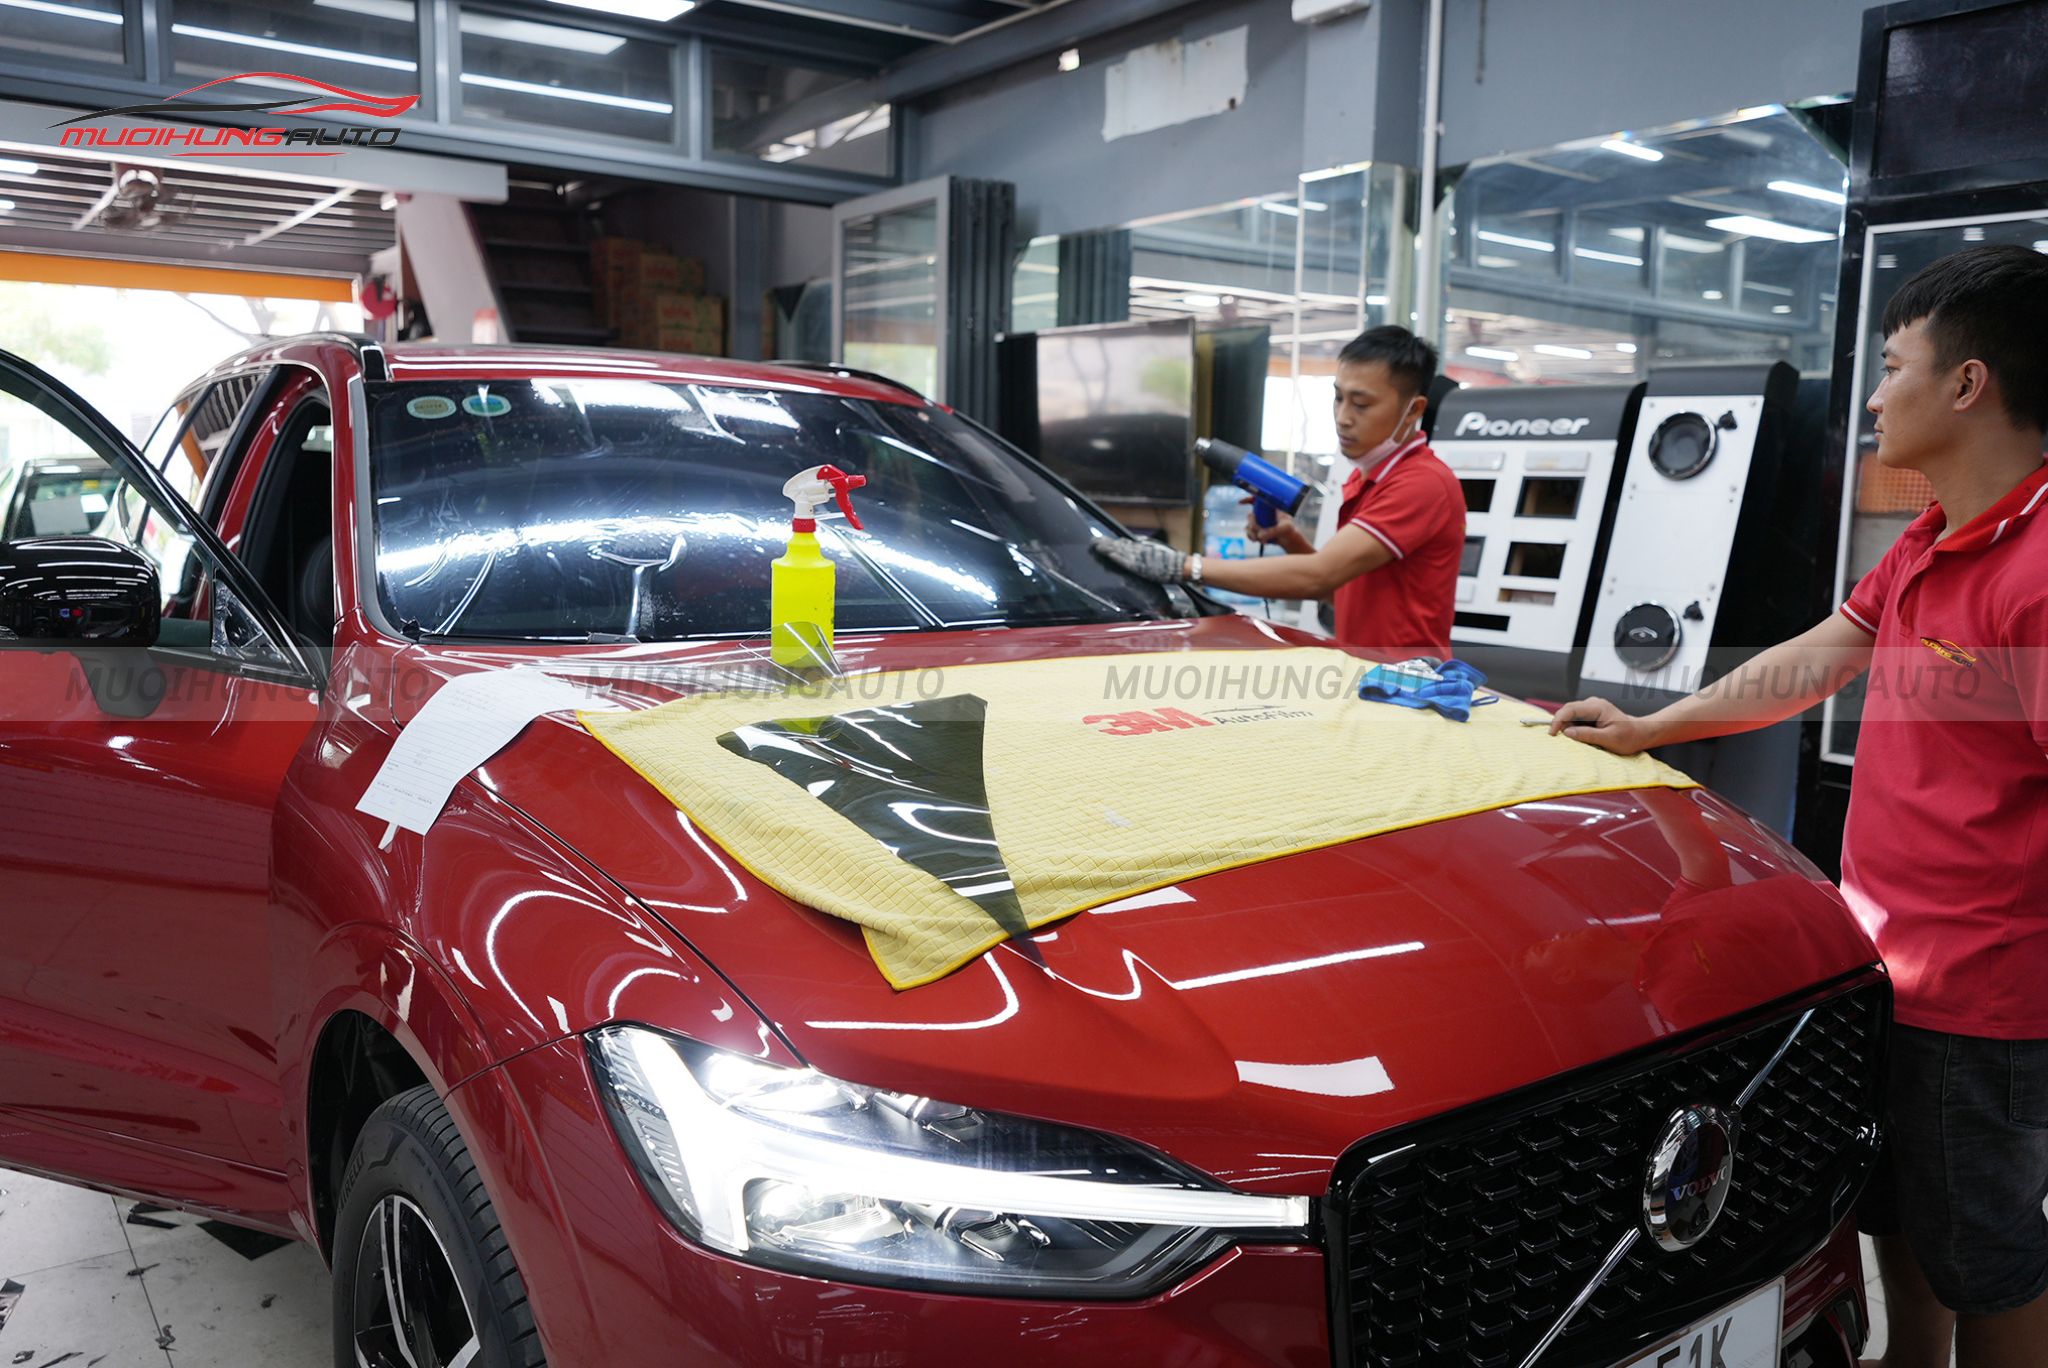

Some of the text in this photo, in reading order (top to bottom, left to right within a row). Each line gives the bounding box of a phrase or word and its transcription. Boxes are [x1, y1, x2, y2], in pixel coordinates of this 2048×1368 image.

[1455, 411, 1590, 437] Pioneer
[1082, 706, 1315, 736] 3M AutoFilm
[1670, 1165, 1729, 1201] VOLVO
